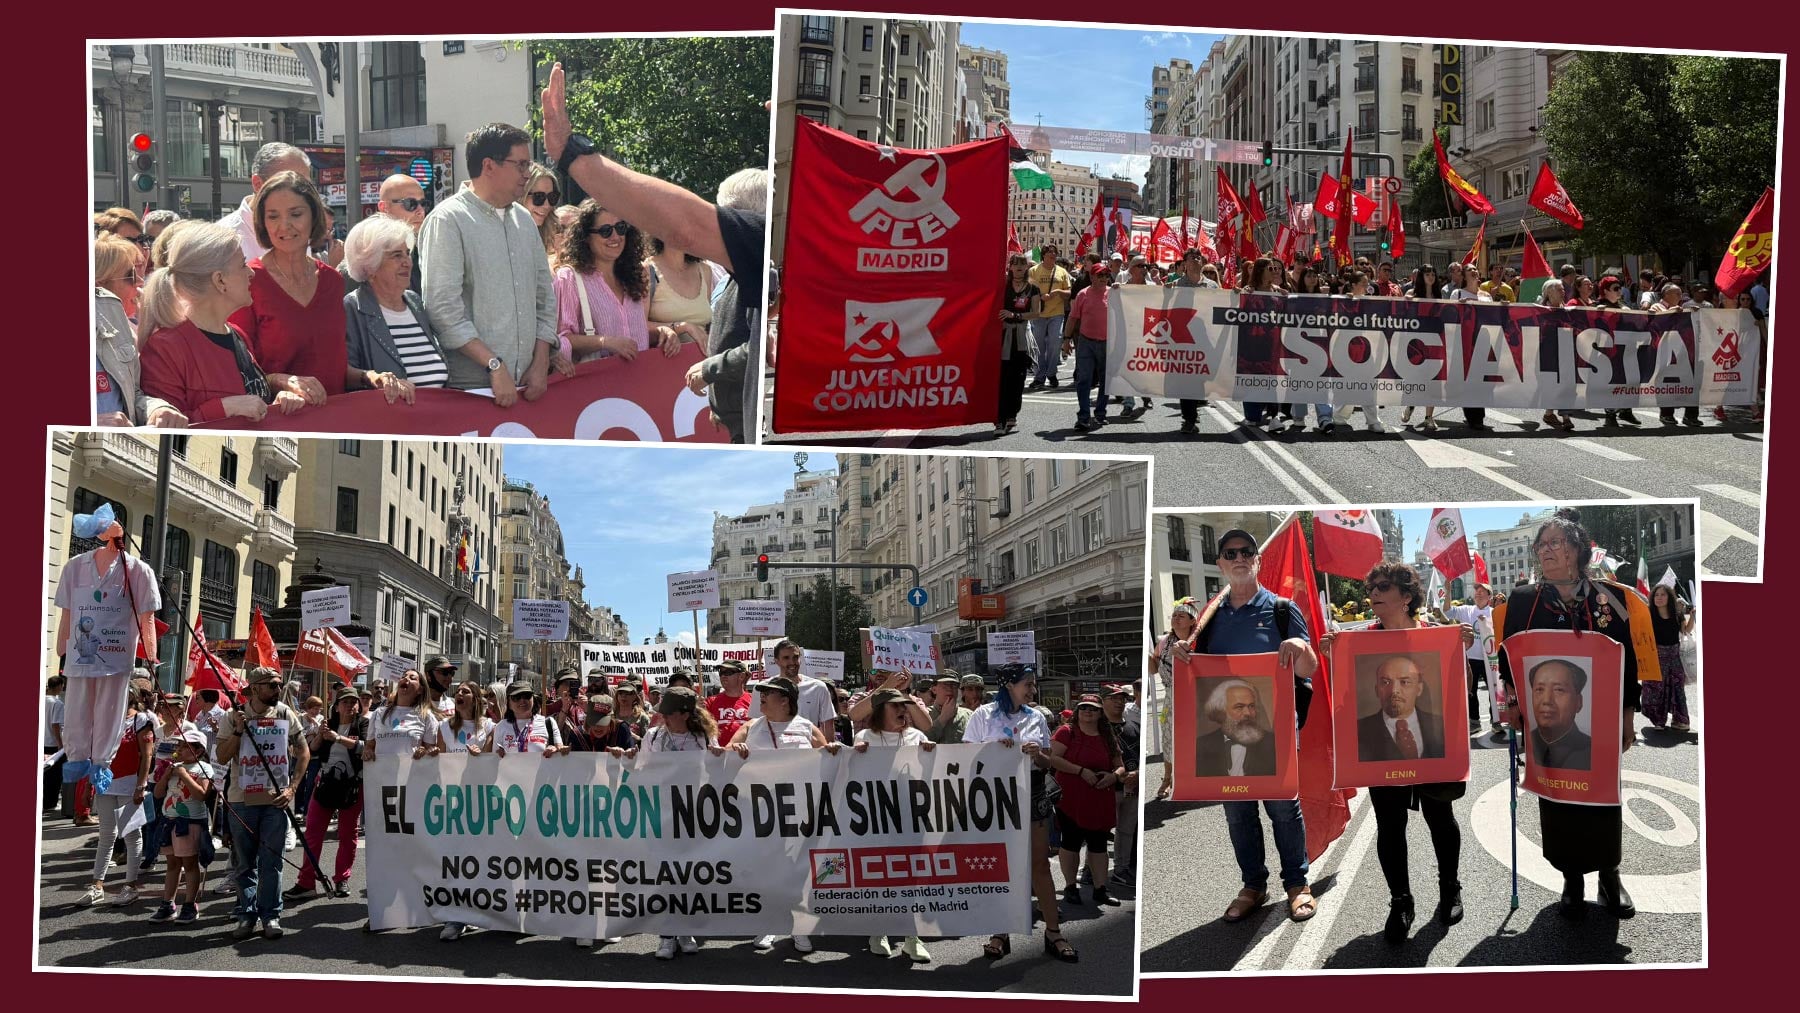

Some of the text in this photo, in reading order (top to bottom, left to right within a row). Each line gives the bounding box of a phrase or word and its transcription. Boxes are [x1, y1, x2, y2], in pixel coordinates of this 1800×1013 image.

[861, 212, 948, 247] PCE
[1430, 216, 1466, 232] HOTEL
[862, 252, 945, 269] MADRID
[1224, 308, 1420, 329] Construyendo el futuro
[1133, 347, 1206, 362] JUVENTUD
[1280, 323, 1696, 384] SOCIALISTA
[1126, 360, 1210, 375] COMUNISTA
[1715, 357, 1738, 370] PCE
[825, 365, 961, 391] JUVENTUD
[1235, 376, 1426, 393] Trabajo digno para una vida digna
[1612, 384, 1694, 396] #FuturoSocialista
[813, 386, 968, 412] COMUNISTA
[873, 629, 907, 643] Quirón
[584, 649, 600, 662] Por
[602, 650, 611, 662] la
[612, 650, 647, 663] MEJORA
[651, 650, 667, 663] del
[874, 645, 892, 653] nos
[600, 665, 625, 674] CONTRA
[875, 655, 933, 670] ASFIXIA
[1385, 769, 1416, 779] LENIN
[1222, 785, 1249, 793] MARX
[381, 761, 1022, 839] EL GRUPO QUIRÓN NOS DEJA SIN RIÑÓN
[441, 855, 733, 886] NO SOMOS ESCLAVOS
[860, 852, 958, 880] CCOO
[813, 884, 1010, 901] federación de sanidad y sectores
[423, 884, 763, 918] SOMOS #PROFESIONALES
[813, 899, 969, 915] sociosanitarios de Madrid
